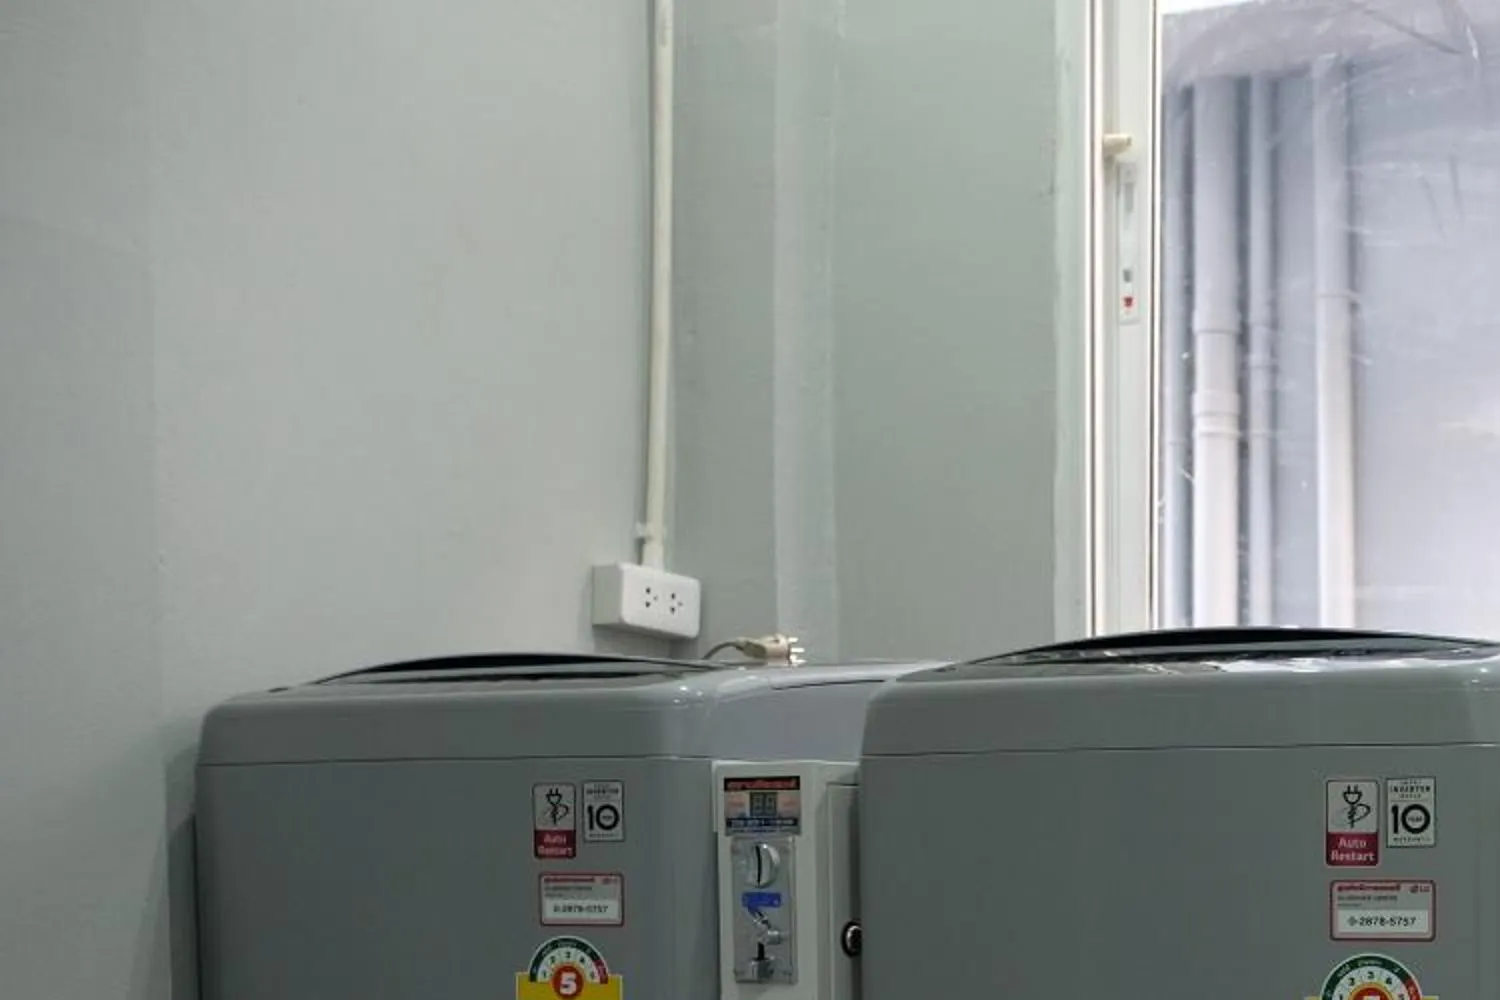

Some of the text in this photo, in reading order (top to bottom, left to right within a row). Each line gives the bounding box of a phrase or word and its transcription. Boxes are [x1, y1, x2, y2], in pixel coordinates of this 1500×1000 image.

[586, 803, 620, 831] 10
[1391, 803, 1431, 835] 10
[1337, 837, 1367, 848] Auto
[1330, 850, 1375, 862] Restart
[559, 971, 577, 995] 5
